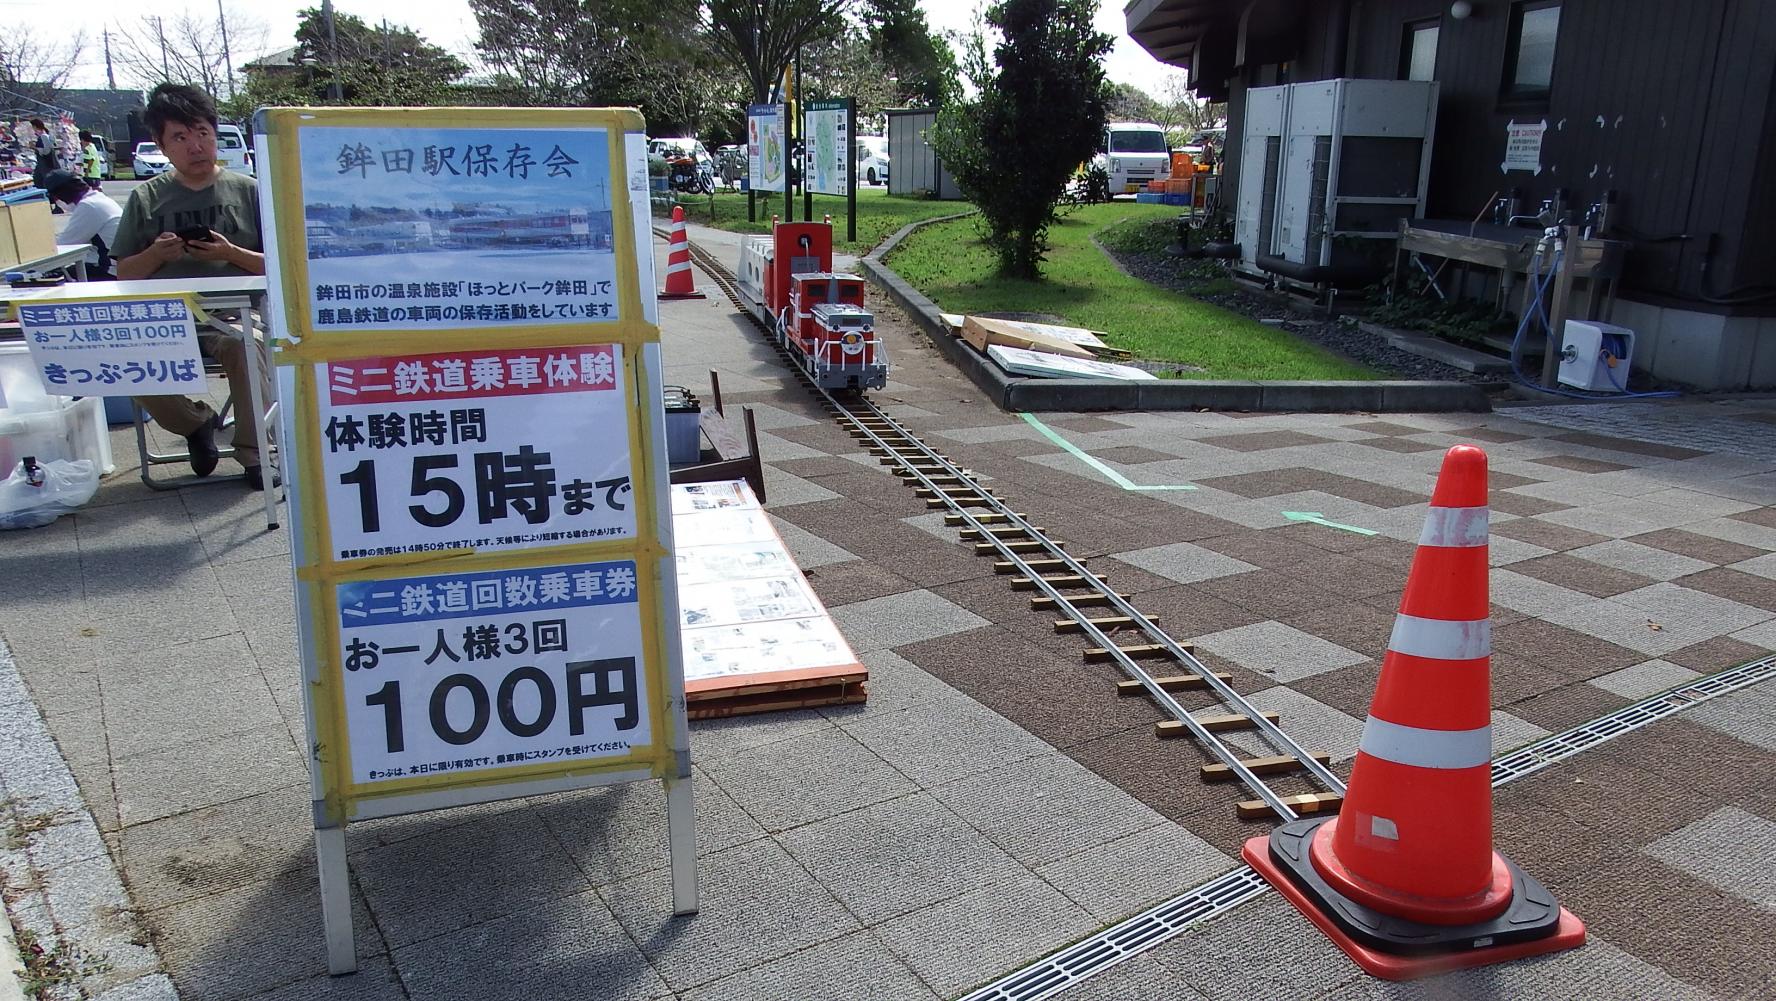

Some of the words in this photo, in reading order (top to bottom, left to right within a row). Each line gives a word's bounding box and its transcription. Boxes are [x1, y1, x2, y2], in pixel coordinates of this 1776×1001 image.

[336, 143, 580, 180] 鉾田駅保存会
[316, 280, 612, 301] 鉾田市の温泉施設「ほっとパーク鉾田」で
[23, 302, 187, 323] ミニ鉄道回数乗車券
[317, 303, 613, 325] 鹿島鉄道の車両の保存活動をしています
[34, 324, 187, 343] お一人様3回100円
[44, 358, 199, 384] きっぷうりば
[331, 351, 615, 397] ミニ鉄道乗車体験
[324, 407, 487, 453] 体験時間
[345, 617, 568, 673] お一人様3回
[365, 656, 640, 754] 100円
